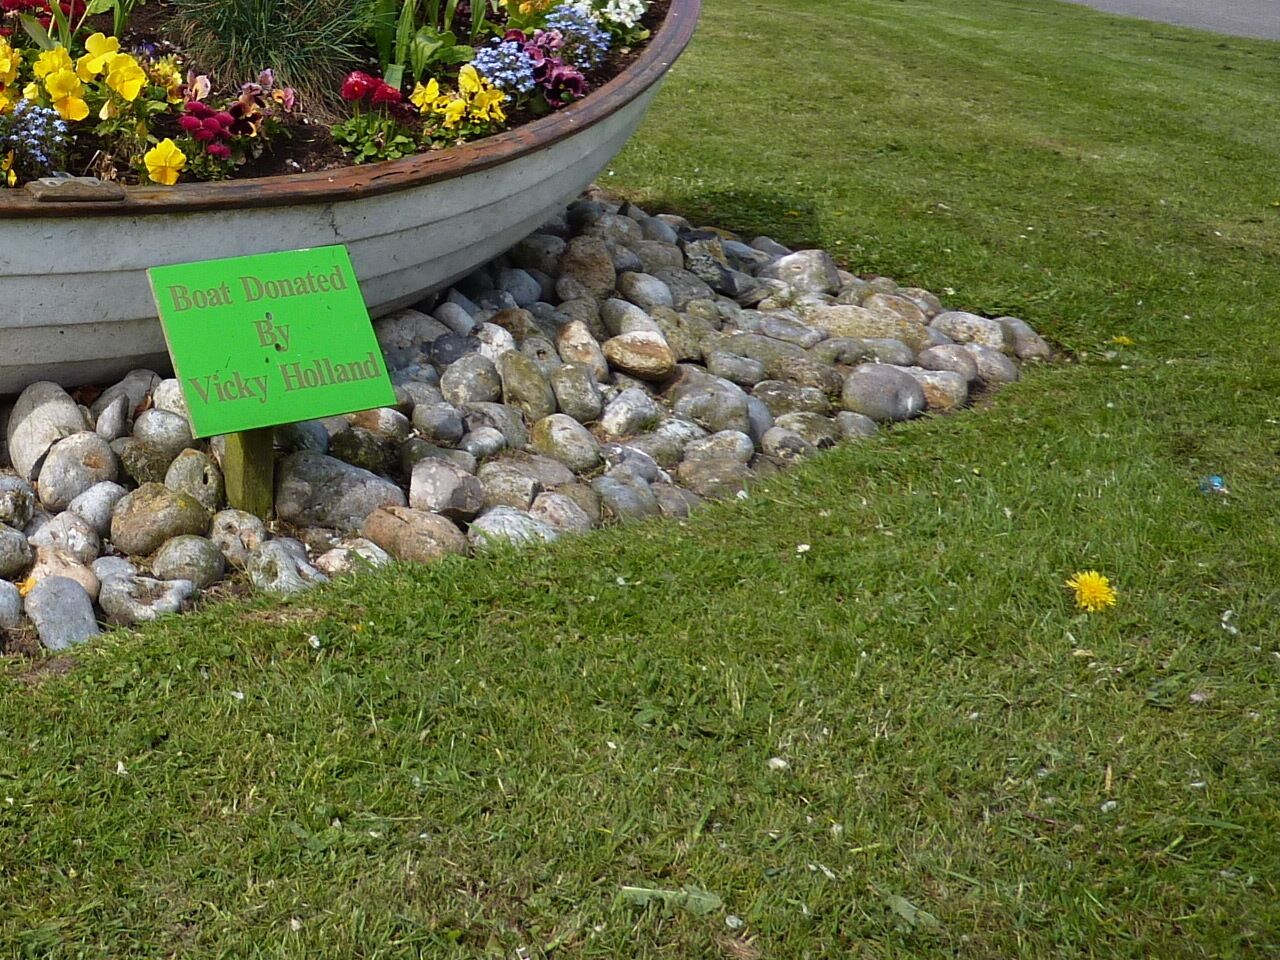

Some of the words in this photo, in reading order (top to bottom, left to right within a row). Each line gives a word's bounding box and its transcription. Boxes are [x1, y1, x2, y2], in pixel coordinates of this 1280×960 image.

[167, 281, 233, 312] Boat
[239, 265, 348, 302] Donated
[252, 319, 290, 351] By
[188, 370, 269, 405] Vicky
[278, 352, 382, 392] Holland
